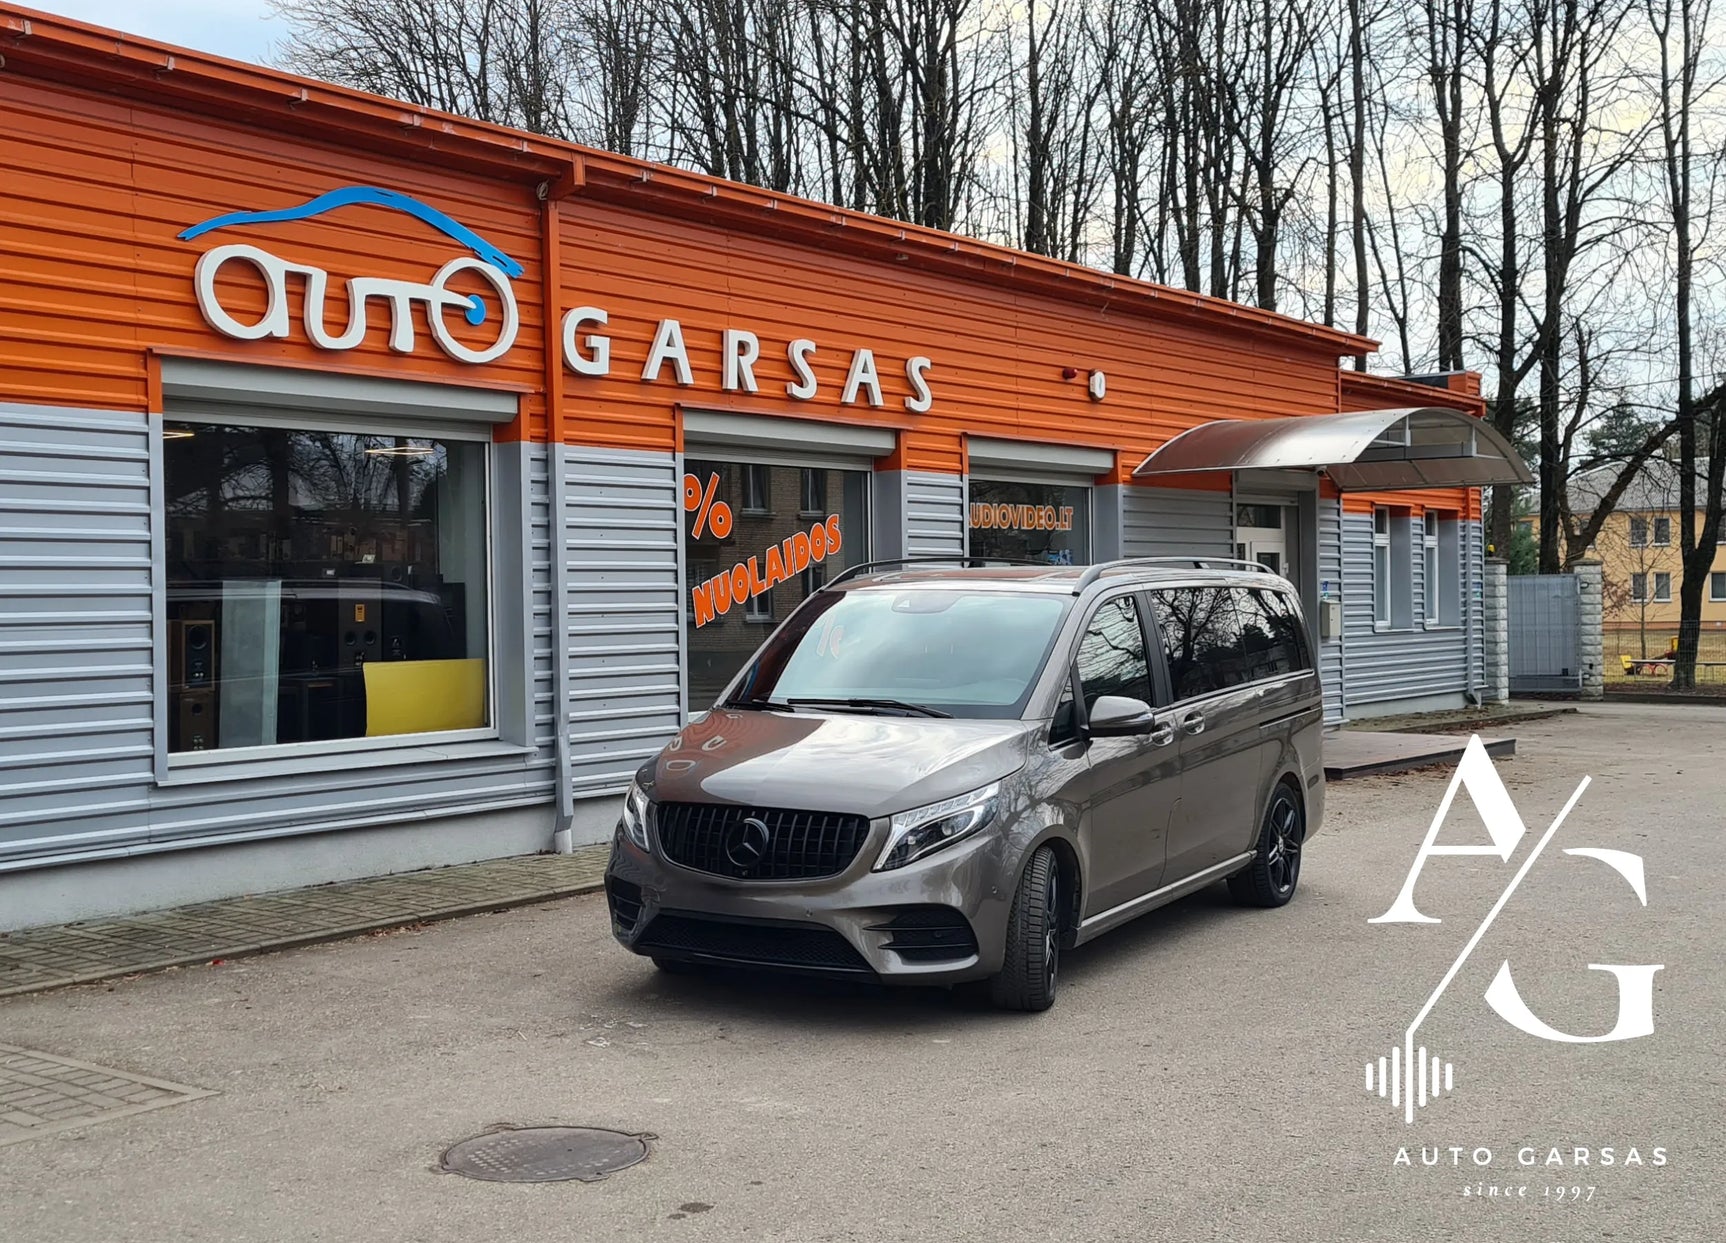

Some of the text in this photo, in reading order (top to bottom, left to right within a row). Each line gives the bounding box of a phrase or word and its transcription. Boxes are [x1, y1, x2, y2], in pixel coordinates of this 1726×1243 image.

[562, 307, 933, 412] GARSAS
[684, 473, 733, 539] %
[969, 503, 1074, 530] UDIOVIDEO.LT
[692, 514, 842, 628] NUOLAIDOS
